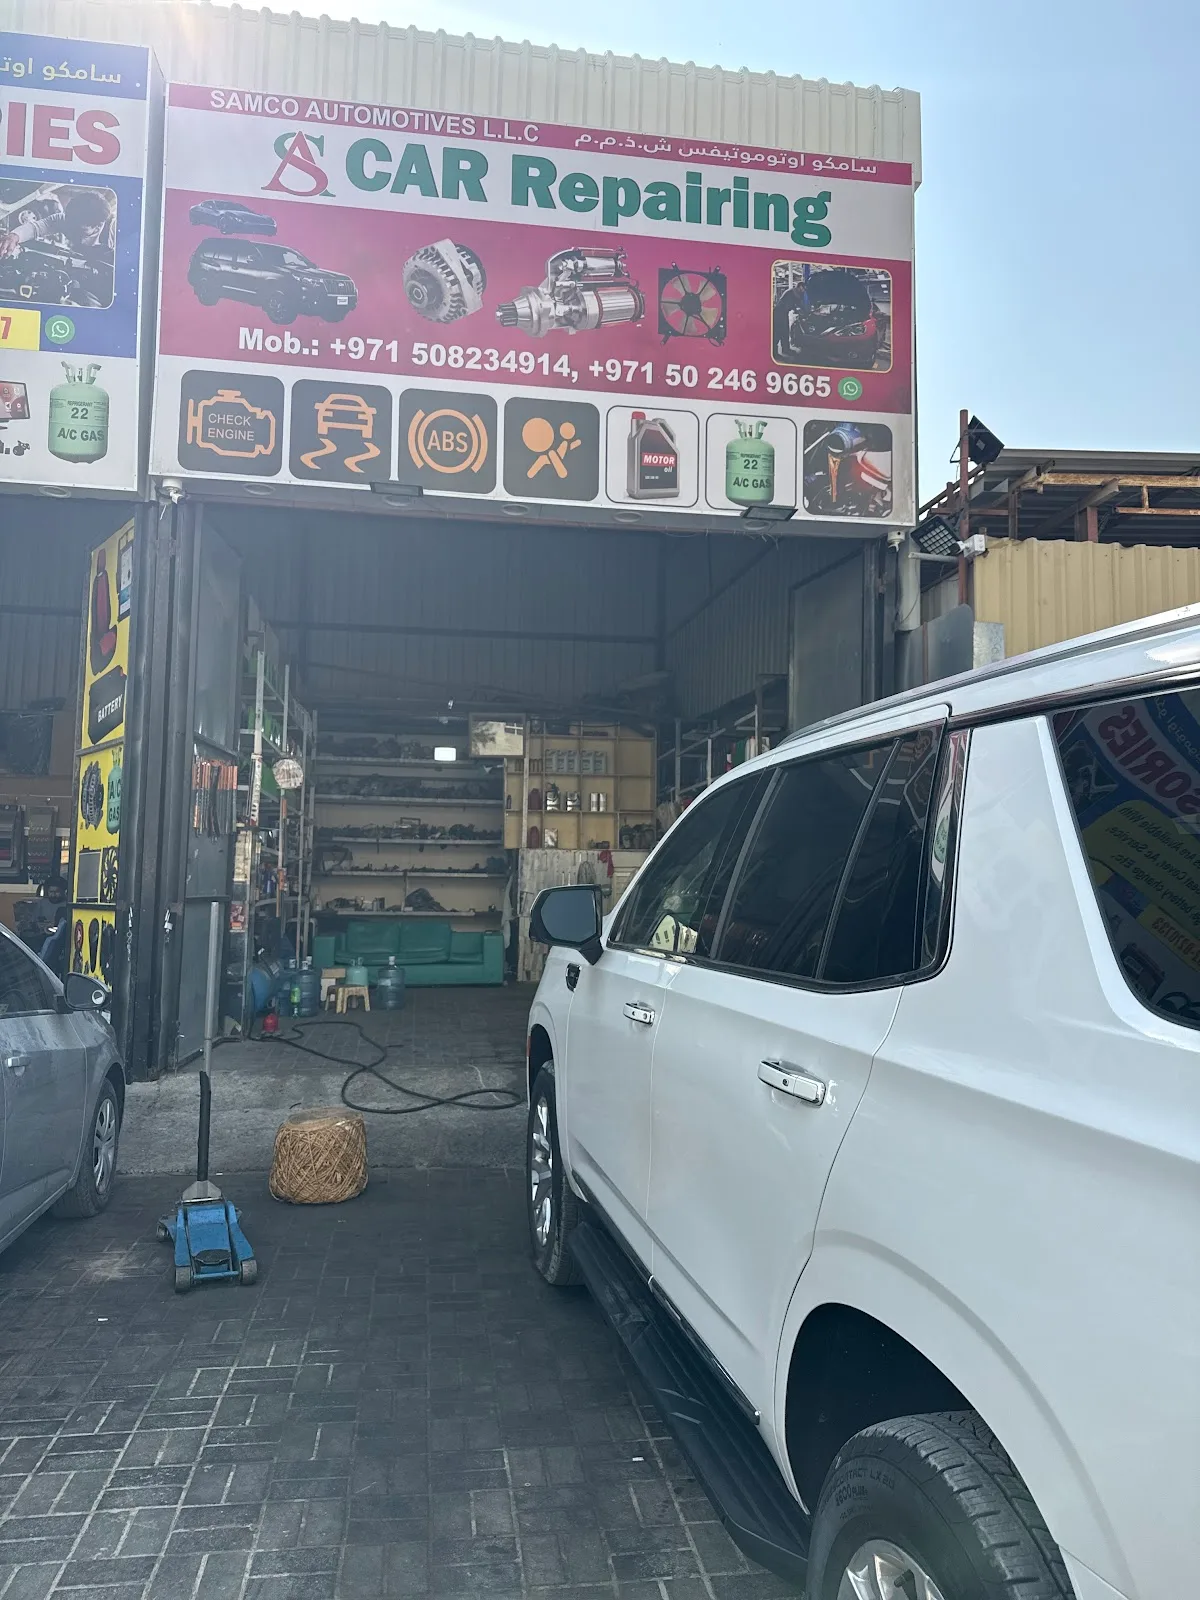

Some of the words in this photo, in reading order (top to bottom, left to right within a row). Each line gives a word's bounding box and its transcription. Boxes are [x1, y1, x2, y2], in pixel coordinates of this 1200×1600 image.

[42, 61, 121, 83] سامكو
[210, 90, 300, 117] SAMCO
[305, 101, 476, 136] AUTOMOTIVES
[484, 119, 539, 142] L.L.C
[0, 101, 121, 166] IES
[678, 145, 805, 169] اوتوموتيفس
[812, 156, 877, 174] سامكو
[345, 137, 489, 203] CAR
[511, 153, 832, 248] Repairing
[238, 326, 319, 356] Mob.:
[330, 336, 399, 363] +971
[411, 342, 579, 384] 508234914,
[588, 358, 654, 384] +971
[665, 364, 699, 388] 50
[707, 368, 757, 393] 246
[766, 372, 831, 398] 9665
[70, 407, 89, 420] 22
[208, 413, 252, 427] CHECK
[57, 427, 77, 441] A/C
[80, 430, 105, 442] GAS
[207, 427, 255, 442] ENGINE
[427, 430, 468, 453] ABS
[643, 454, 675, 465] MOTOR
[743, 459, 758, 470] 22
[732, 477, 749, 488] A/C
[751, 478, 772, 489] GAS
[97, 694, 123, 723] BATTERY
